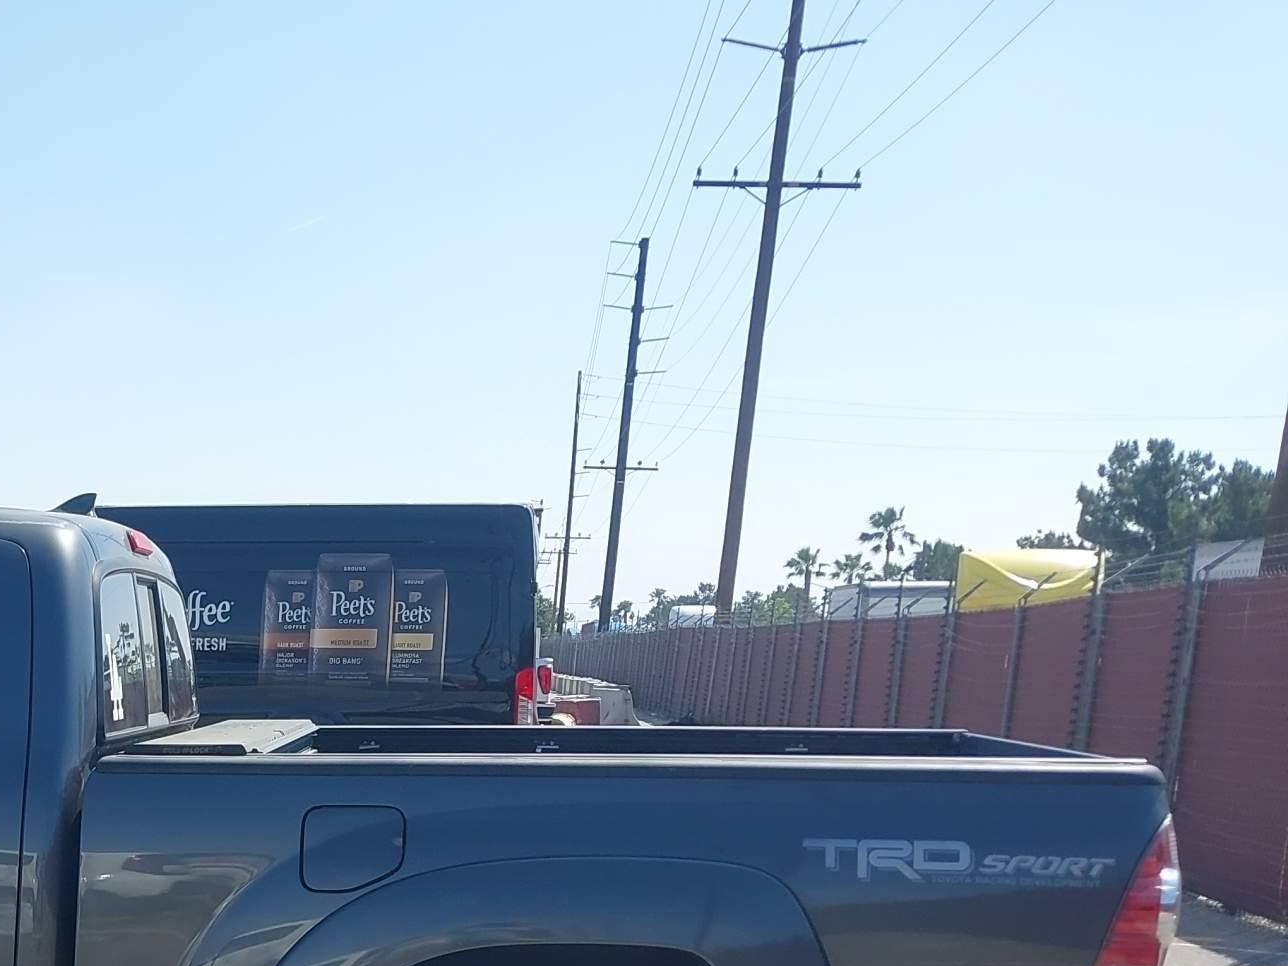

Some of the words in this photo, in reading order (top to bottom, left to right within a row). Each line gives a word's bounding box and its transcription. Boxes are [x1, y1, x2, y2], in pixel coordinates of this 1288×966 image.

[188, 590, 231, 630] ffee
[329, 591, 376, 617] Peet's
[394, 601, 432, 624] Peet's
[802, 838, 976, 883] TRD
[978, 854, 1116, 877] SPORT
[931, 874, 972, 884] TOYOTA
